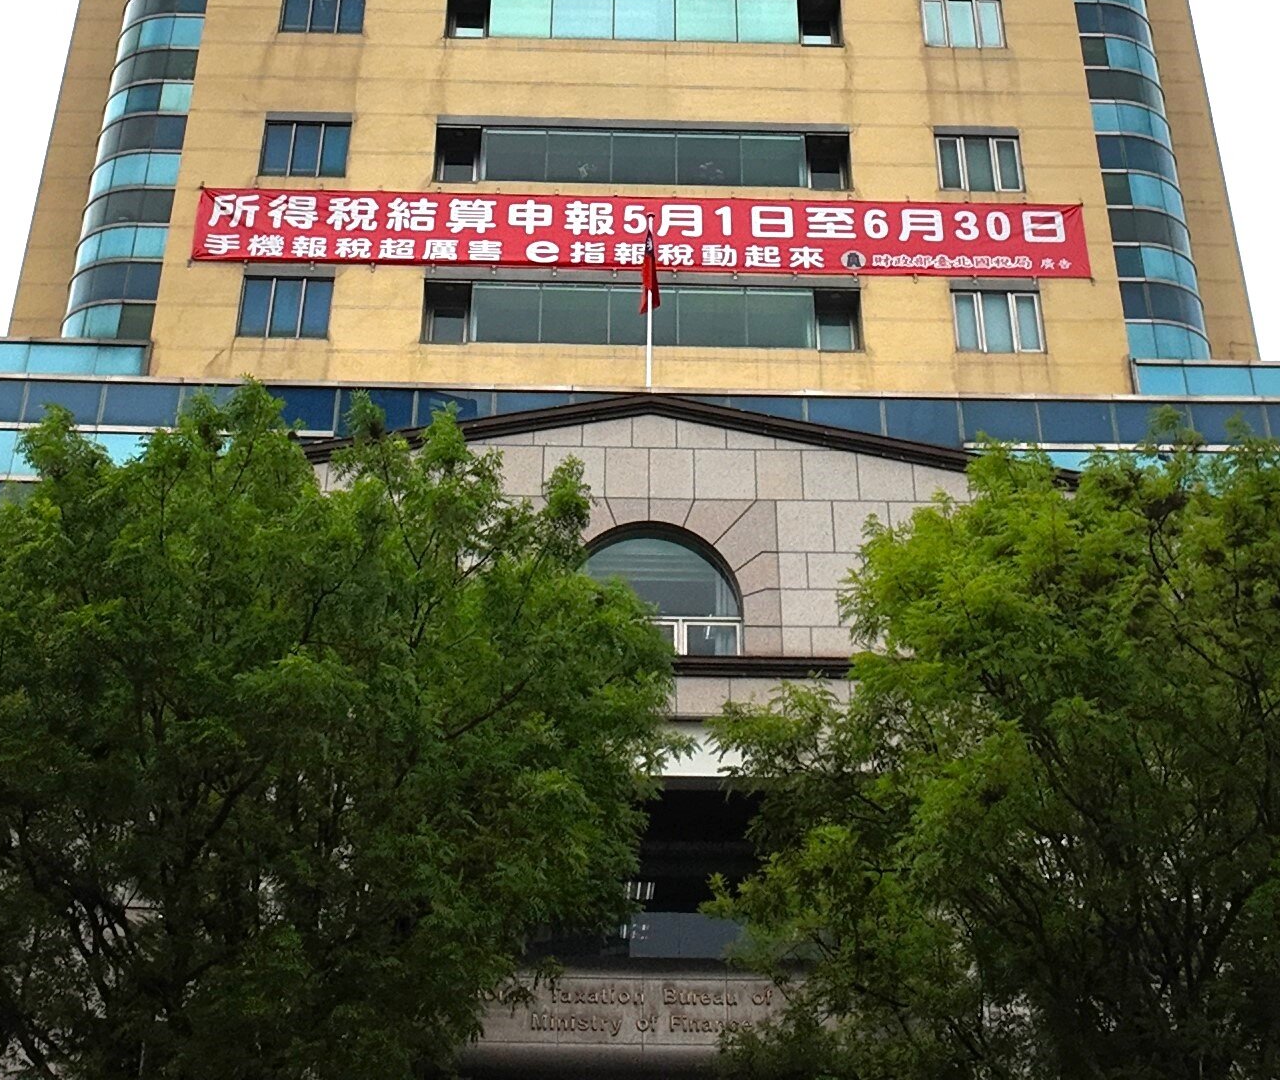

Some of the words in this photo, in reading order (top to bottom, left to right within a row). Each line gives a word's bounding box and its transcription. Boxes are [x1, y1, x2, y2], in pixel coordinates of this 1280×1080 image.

[207, 193, 1067, 243] 所得稅結算申報5月1日至6月30日
[203, 233, 503, 262] 手機報稅超厲害
[549, 986, 645, 1006] Taxation
[662, 988, 738, 1006] Bureau
[751, 989, 772, 1006] of
[530, 1012, 623, 1037] Ministry
[635, 1016, 659, 1033] of
[668, 1015, 753, 1033] Finance
